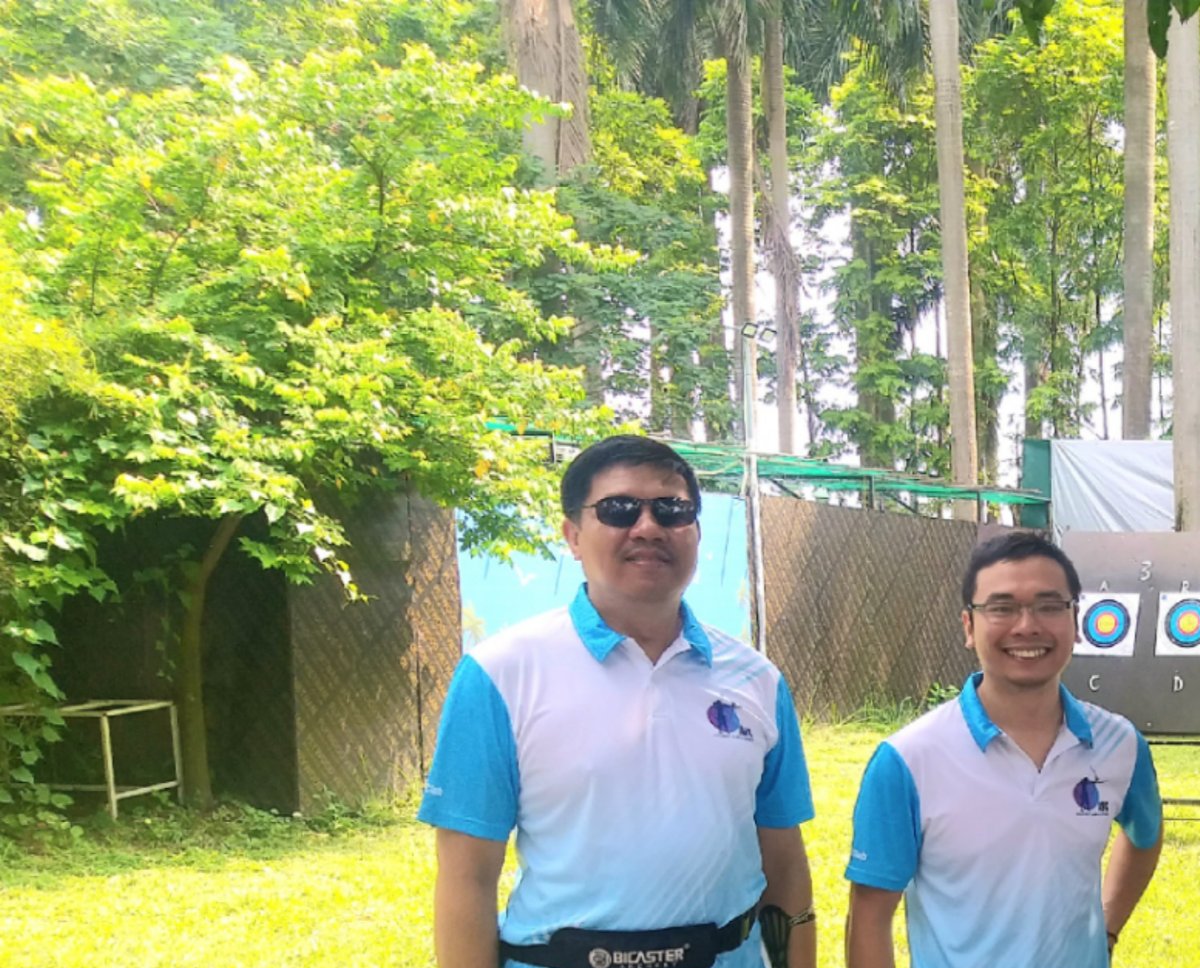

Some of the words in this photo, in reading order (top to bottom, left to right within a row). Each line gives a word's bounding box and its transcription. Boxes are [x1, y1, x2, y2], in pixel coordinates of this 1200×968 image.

[1140, 561, 1152, 581] 3
[1089, 674, 1100, 691] C
[1173, 675, 1184, 692] D
[612, 947, 685, 965] BICASTER
